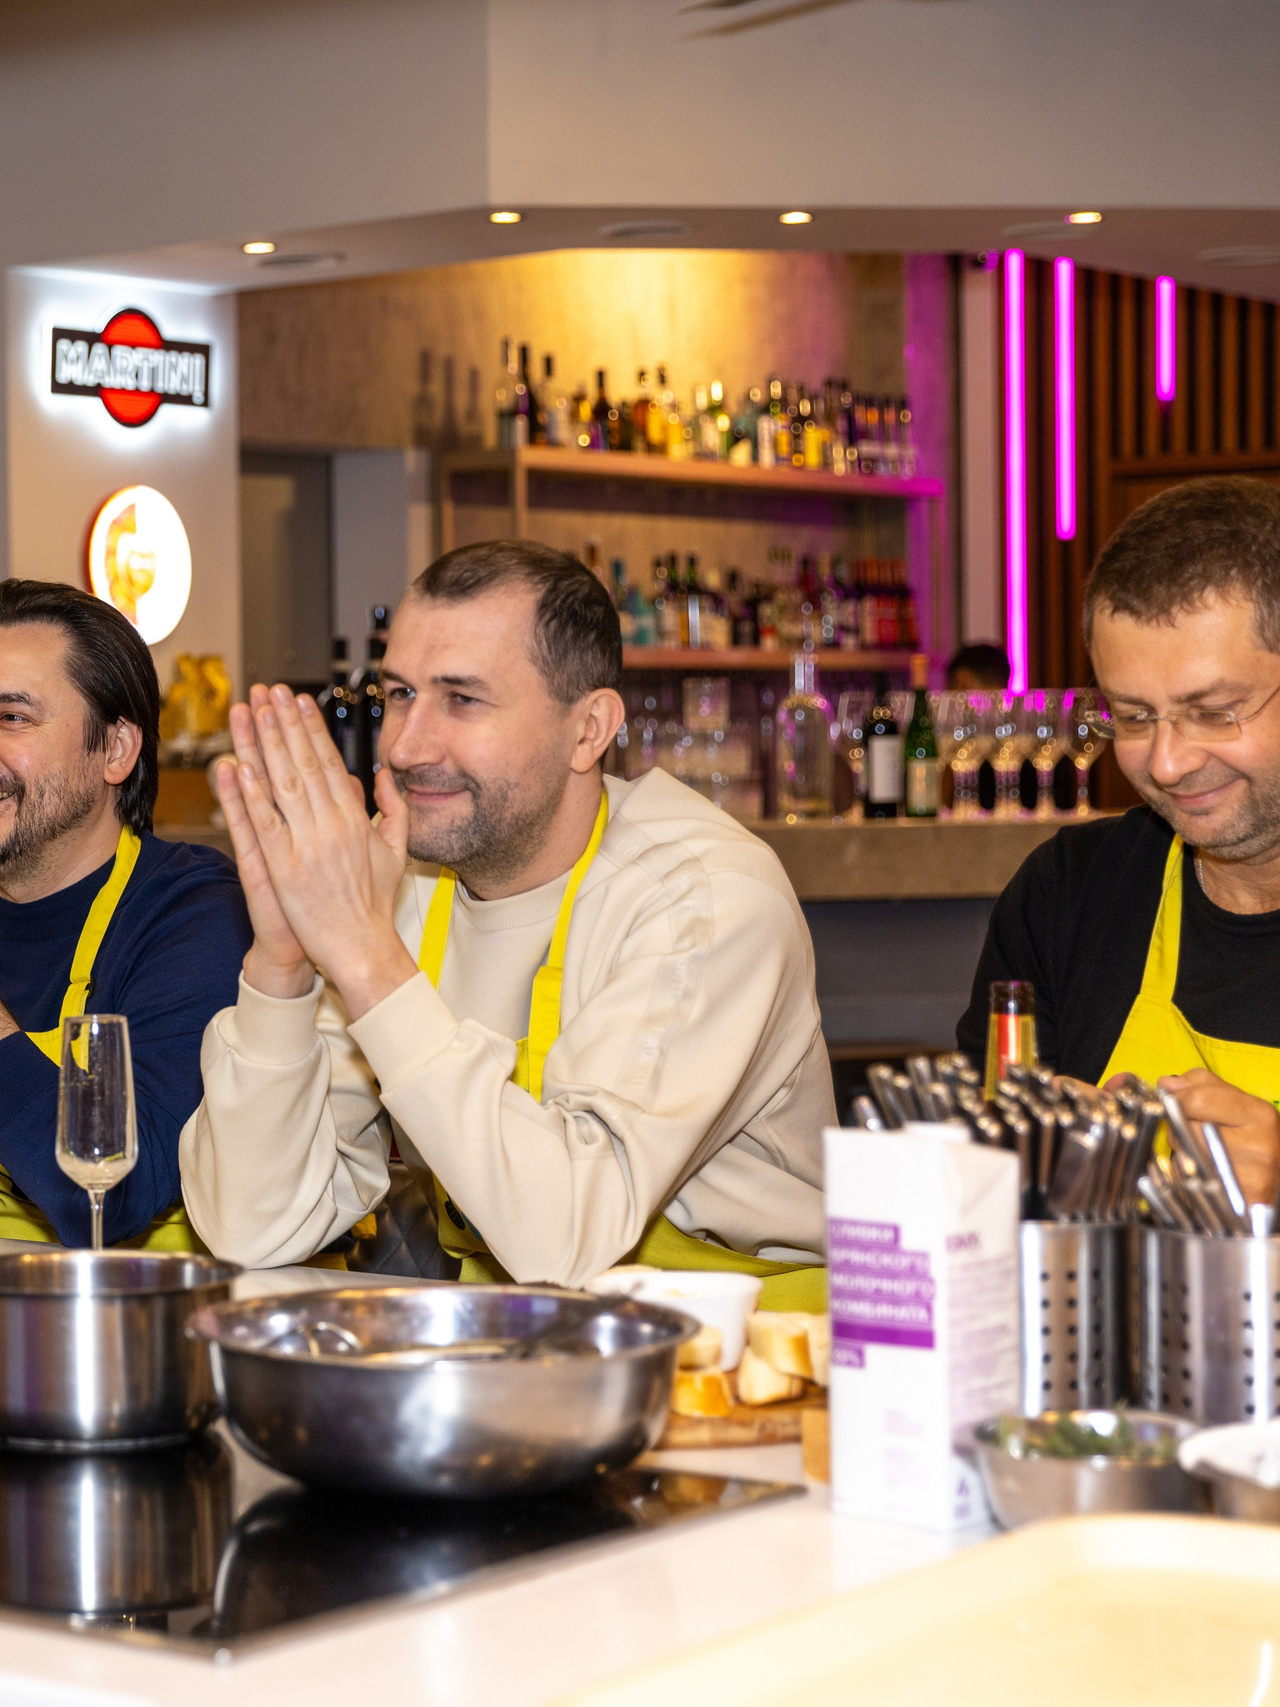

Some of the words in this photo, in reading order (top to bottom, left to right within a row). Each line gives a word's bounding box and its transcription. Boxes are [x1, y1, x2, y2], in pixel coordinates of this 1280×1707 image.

[55, 338, 206, 396] MARTINI
[832, 1272, 935, 1298] МОЛОЧНОГО
[832, 1299, 929, 1322] КОМБИНАТА
